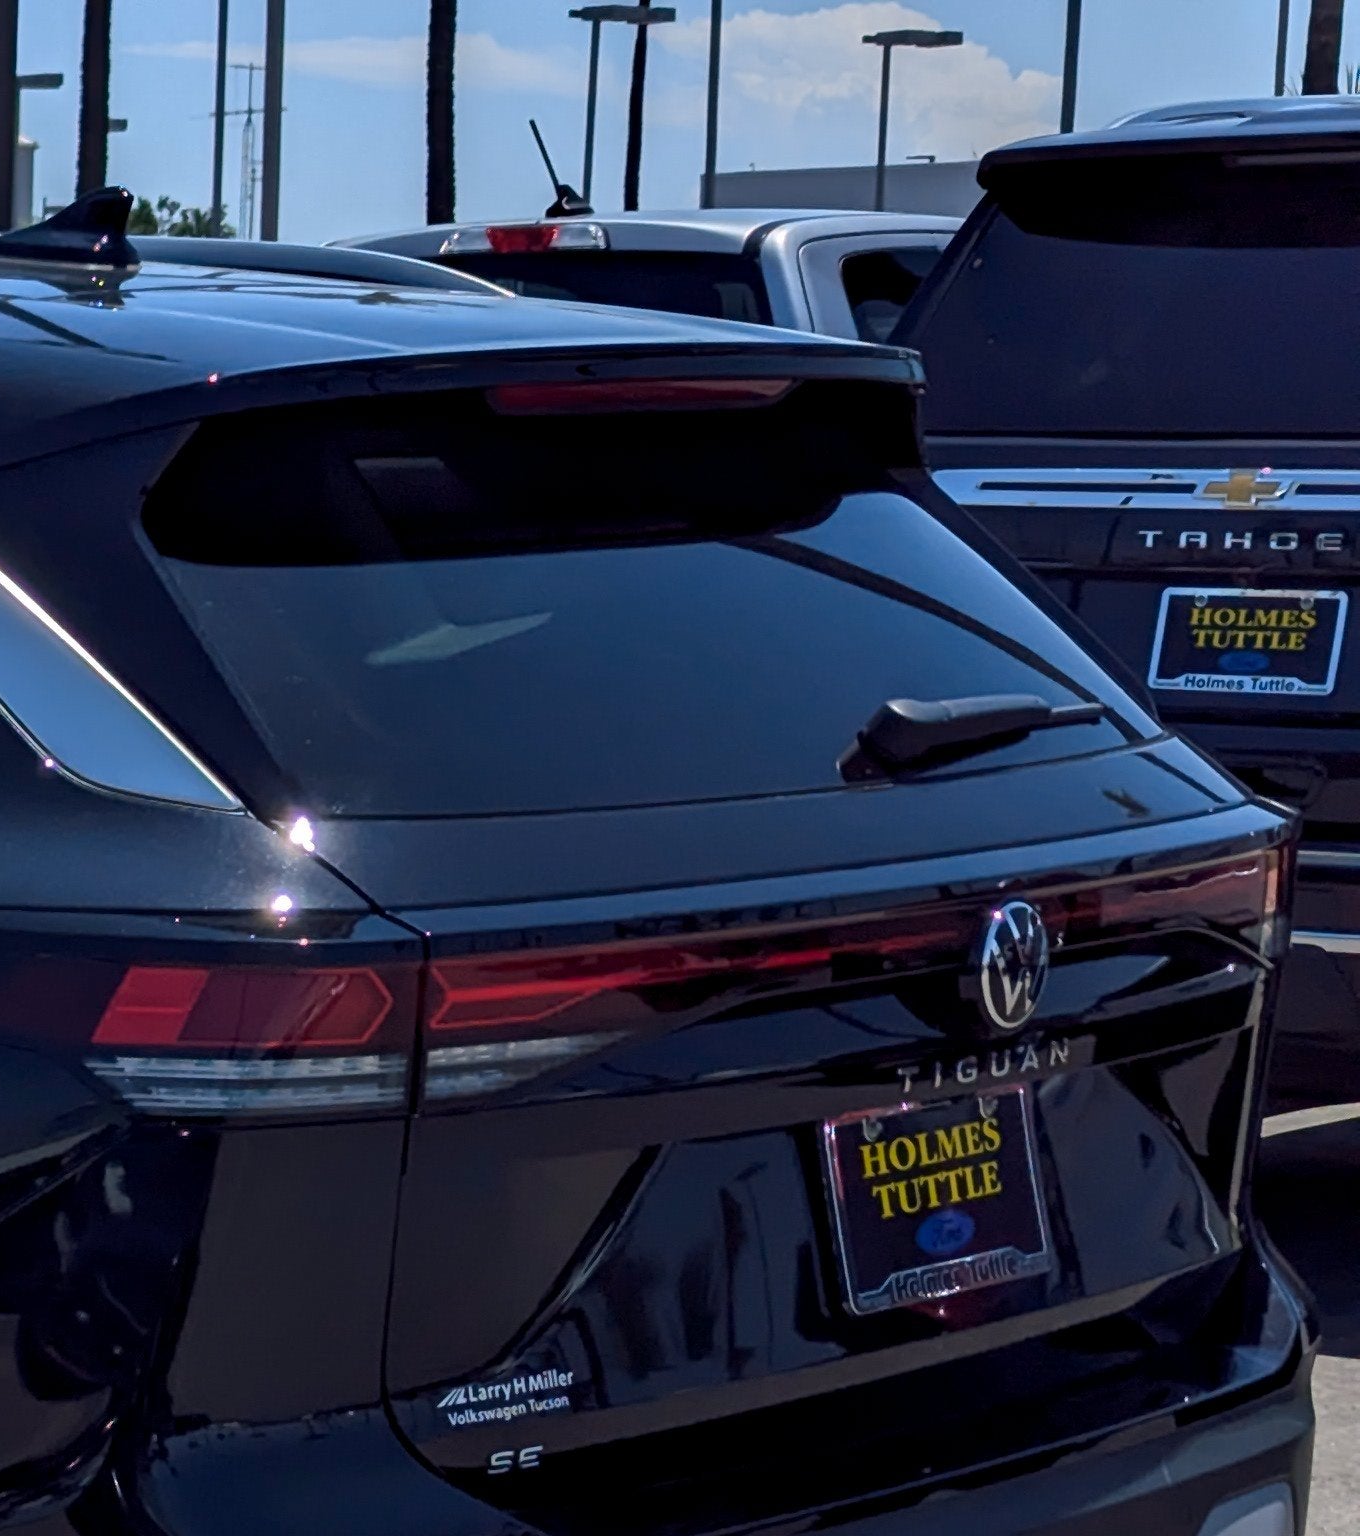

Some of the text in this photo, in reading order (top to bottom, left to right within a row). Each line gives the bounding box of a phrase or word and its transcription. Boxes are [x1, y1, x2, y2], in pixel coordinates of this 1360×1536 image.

[1138, 530, 1344, 551] TAHOE
[1190, 607, 1317, 629] HOLMES
[1192, 628, 1307, 650] TUTTLE
[1184, 675, 1296, 692] Holmes Tuttle
[897, 1037, 1070, 1093] TIGUAN
[859, 1118, 1001, 1178] HOLMES
[872, 1161, 1001, 1219] TUTTLE
[468, 1368, 573, 1403] Larry H Miller
[448, 1395, 570, 1426] Volkswagen Tucson
[487, 1445, 543, 1474] SE
